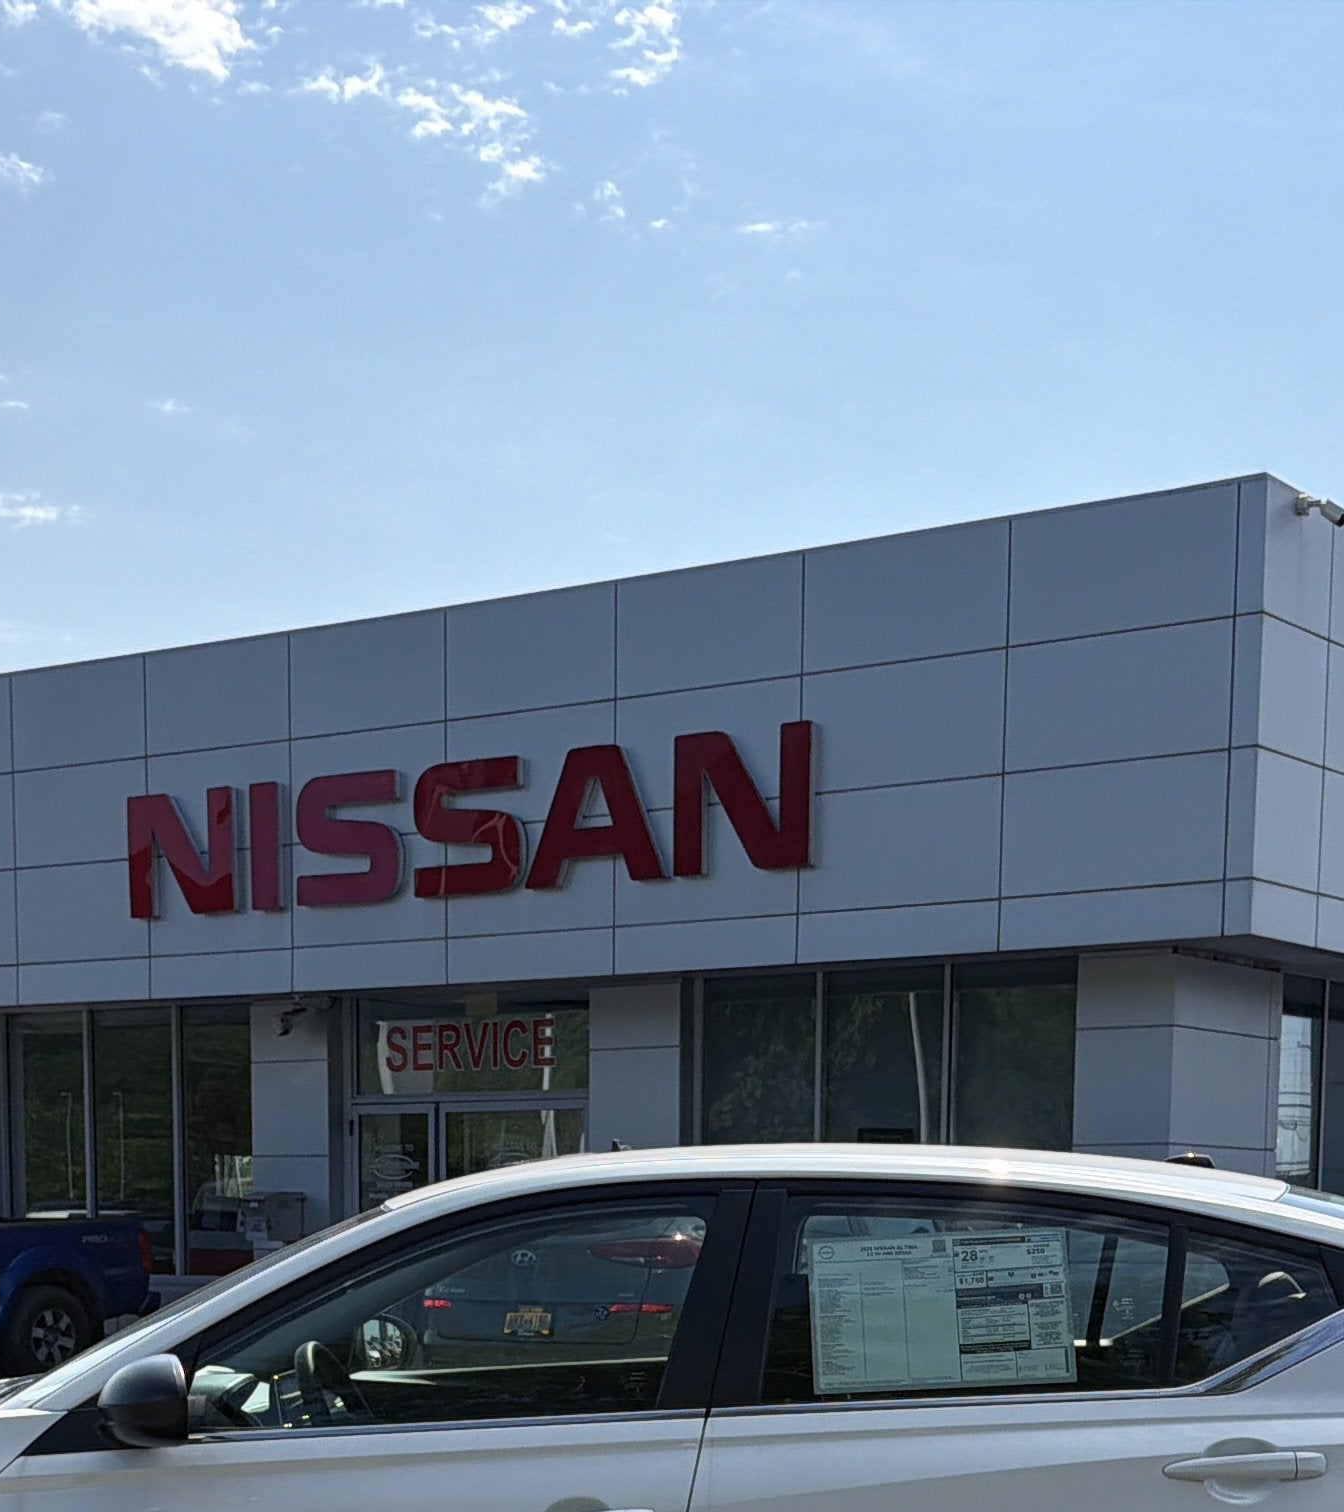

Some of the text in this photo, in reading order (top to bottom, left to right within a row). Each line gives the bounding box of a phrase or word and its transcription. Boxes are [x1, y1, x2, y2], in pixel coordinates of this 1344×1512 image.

[127, 720, 814, 919] NISSAN
[385, 1018, 556, 1072] SERVICE
[960, 1249, 978, 1262] 28
